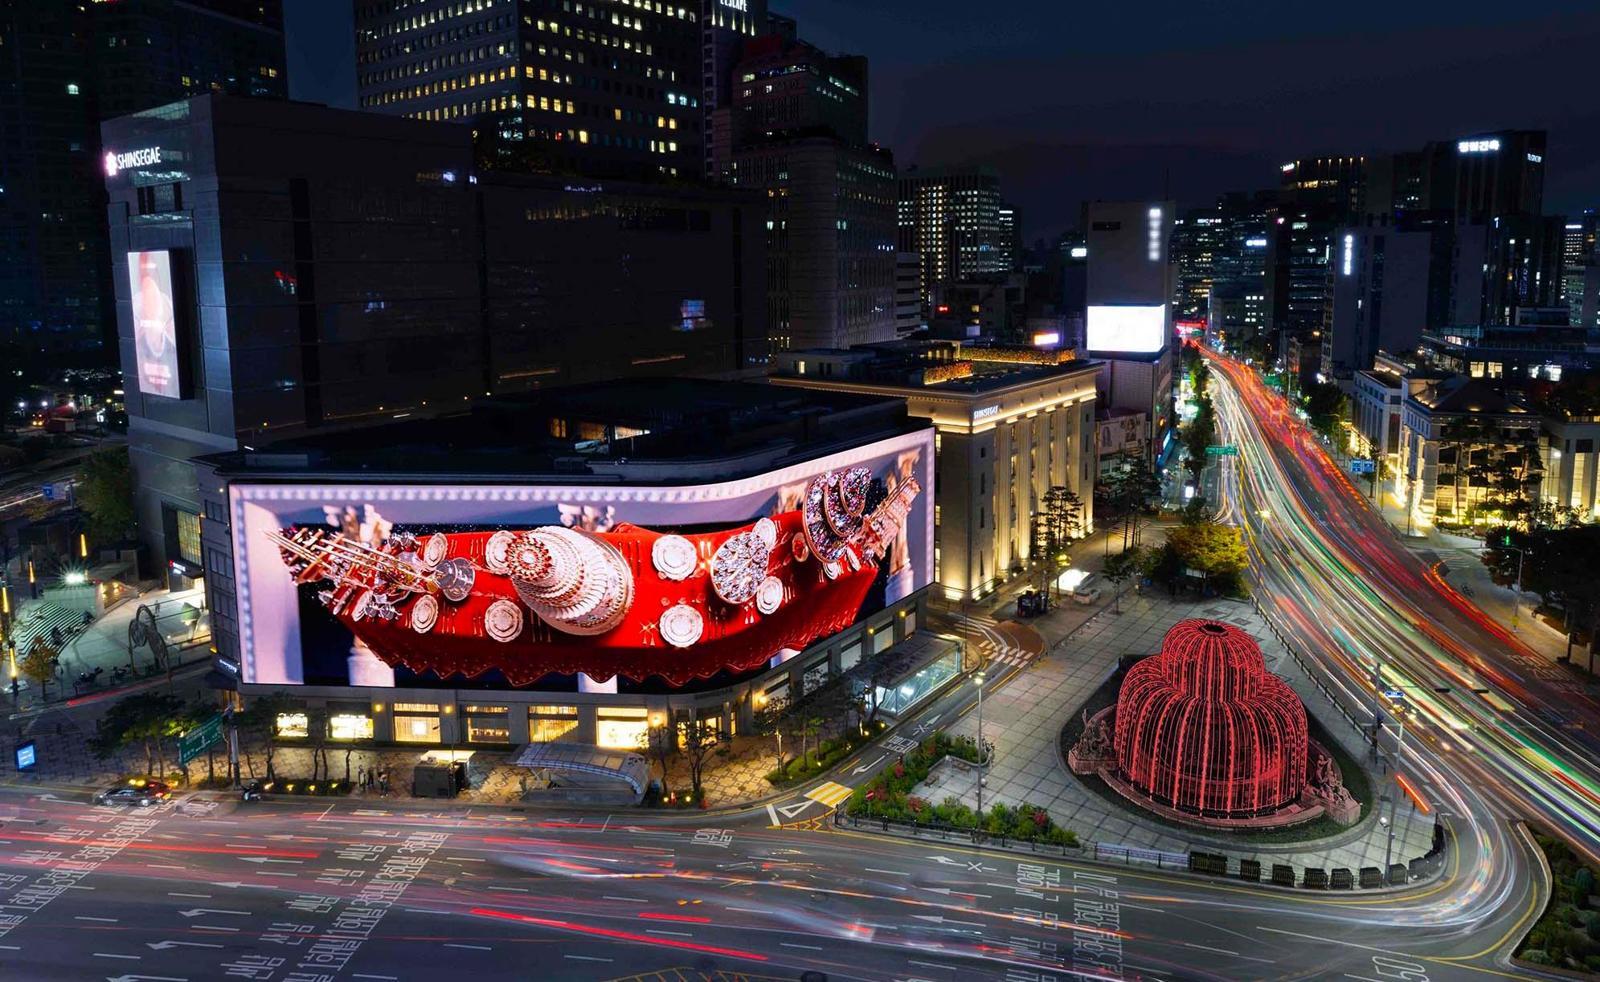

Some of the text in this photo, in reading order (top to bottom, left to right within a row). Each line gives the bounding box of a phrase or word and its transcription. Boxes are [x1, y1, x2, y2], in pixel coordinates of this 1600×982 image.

[117, 146, 161, 169] SHINSEGAE
[397, 831, 449, 855] 3호터널
[376, 855, 429, 881] 3호터널
[351, 880, 412, 908] 3호터널
[326, 908, 387, 936] 1호터널
[297, 940, 363, 971] 1호터널
